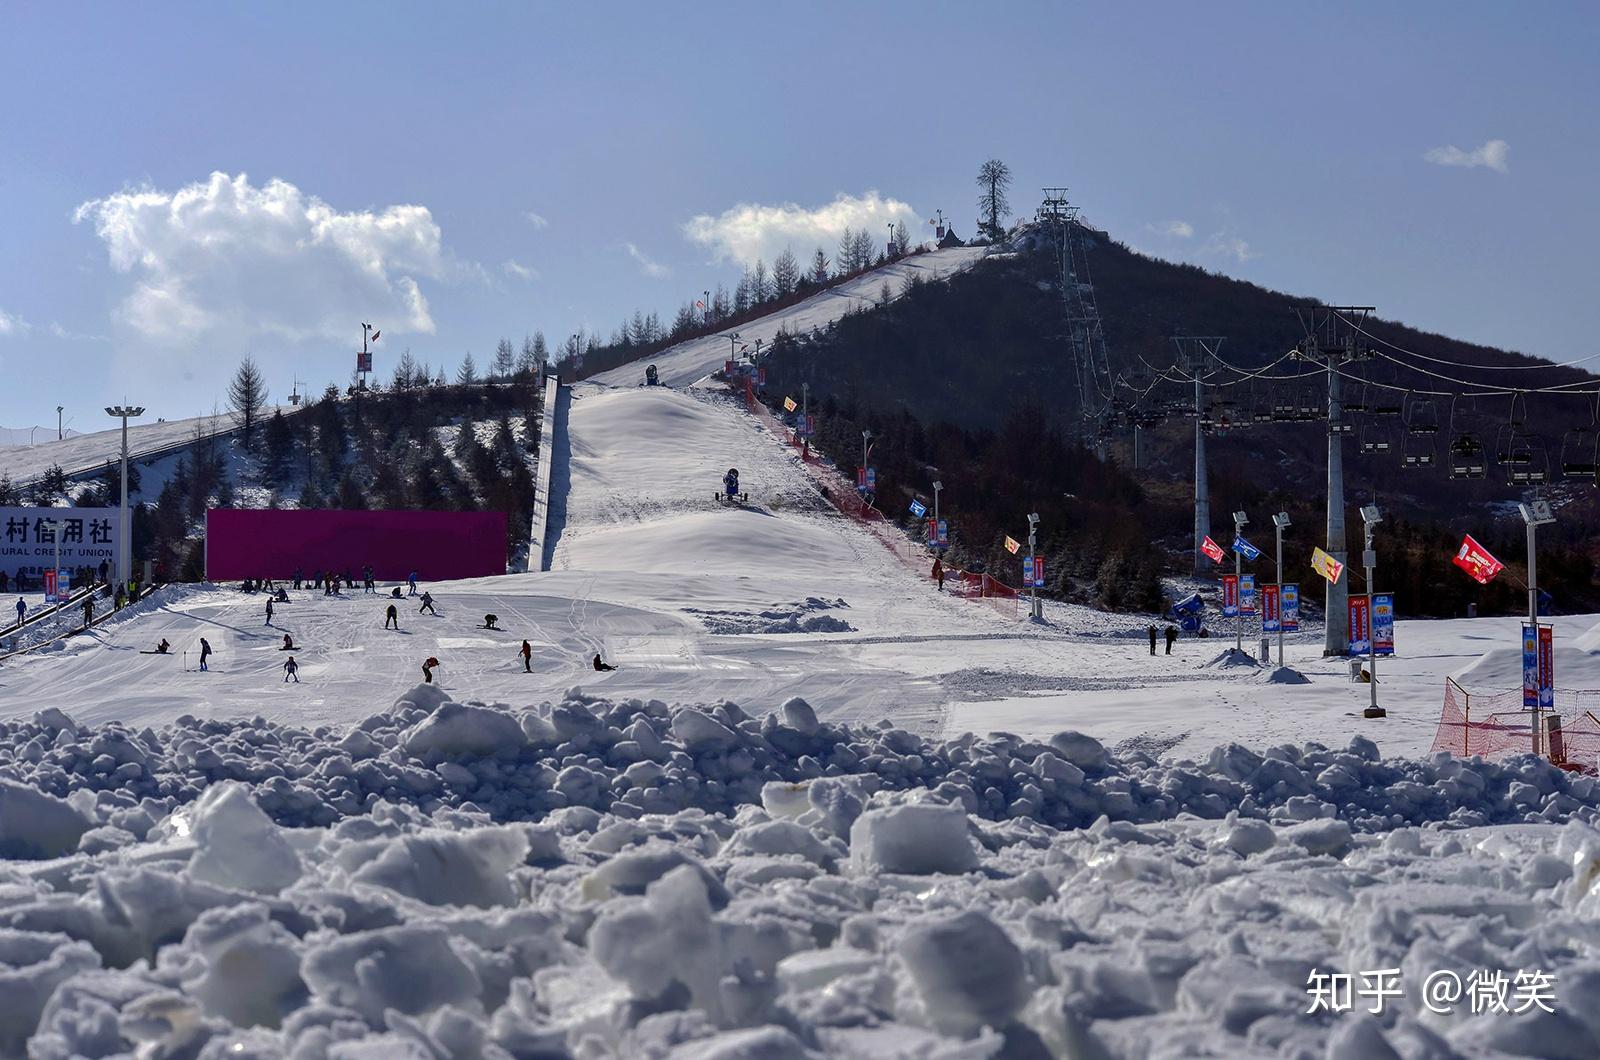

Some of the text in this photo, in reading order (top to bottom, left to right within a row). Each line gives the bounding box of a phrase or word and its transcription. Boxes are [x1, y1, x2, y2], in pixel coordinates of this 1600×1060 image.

[0, 516, 113, 544] 村信用社
[0, 547, 30, 556] URAL
[78, 548, 113, 557] UNION
